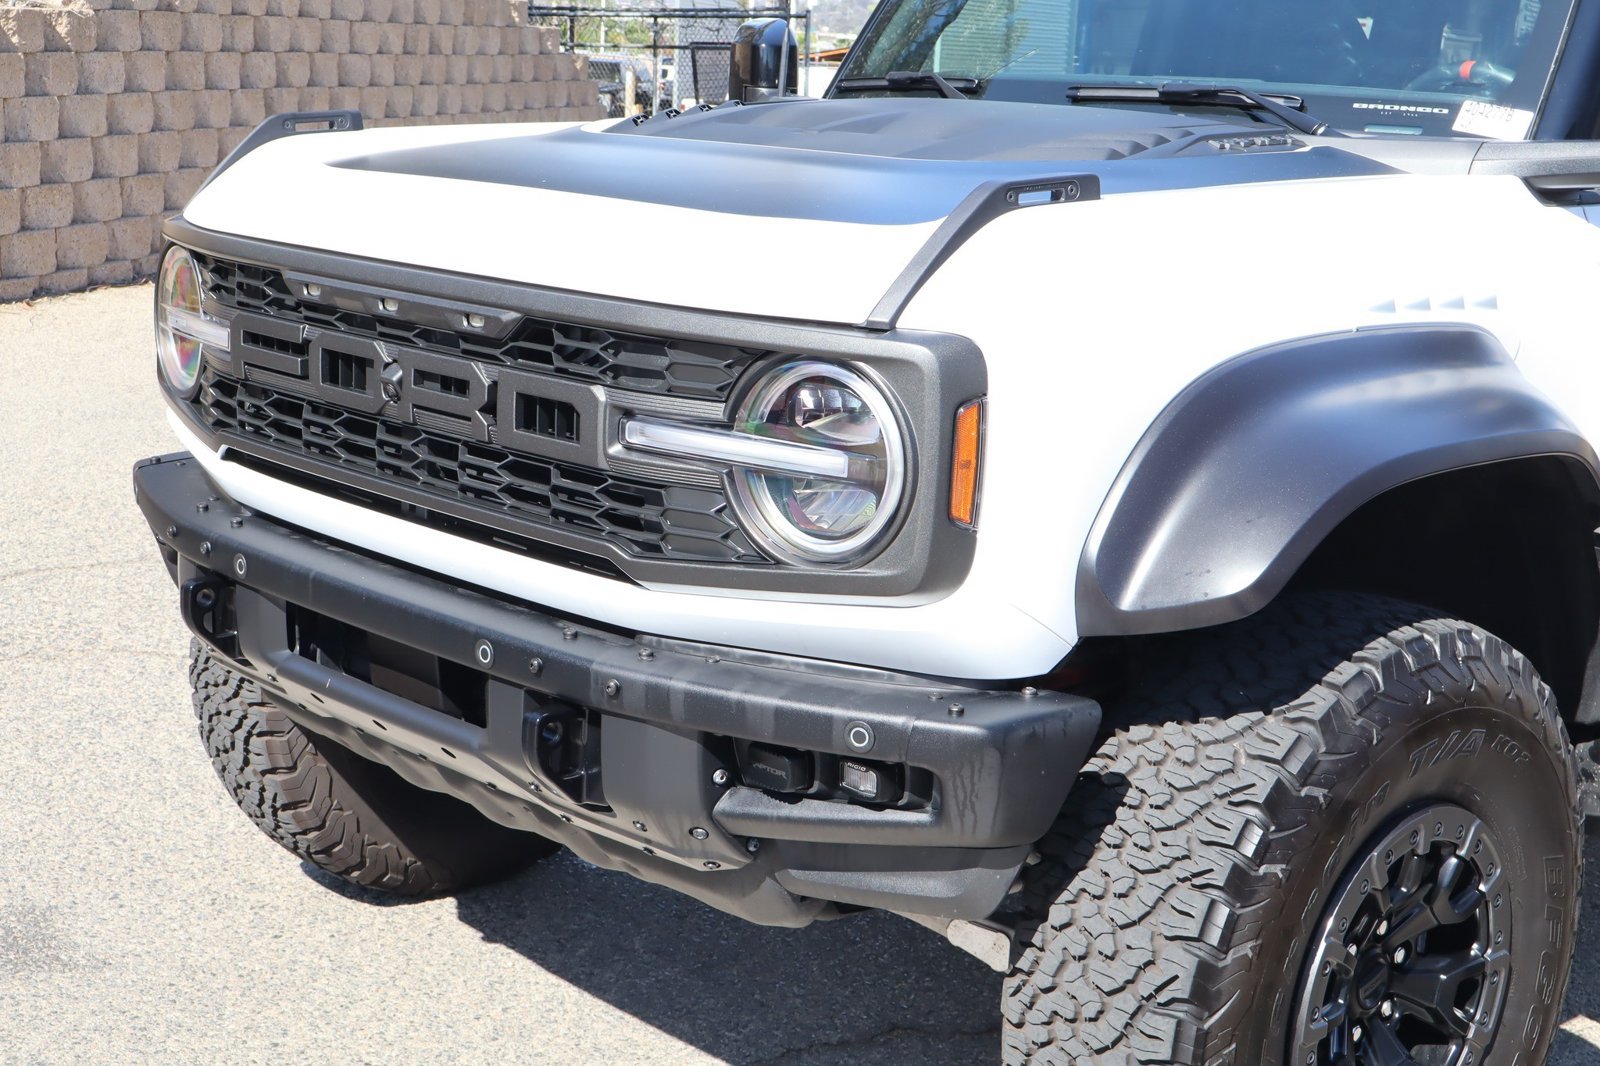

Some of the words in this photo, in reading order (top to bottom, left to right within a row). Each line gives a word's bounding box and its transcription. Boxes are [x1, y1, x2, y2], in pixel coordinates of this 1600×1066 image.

[1352, 102, 1449, 114] BRONCO
[230, 312, 608, 471] FORD
[1407, 728, 1487, 781] T/A
